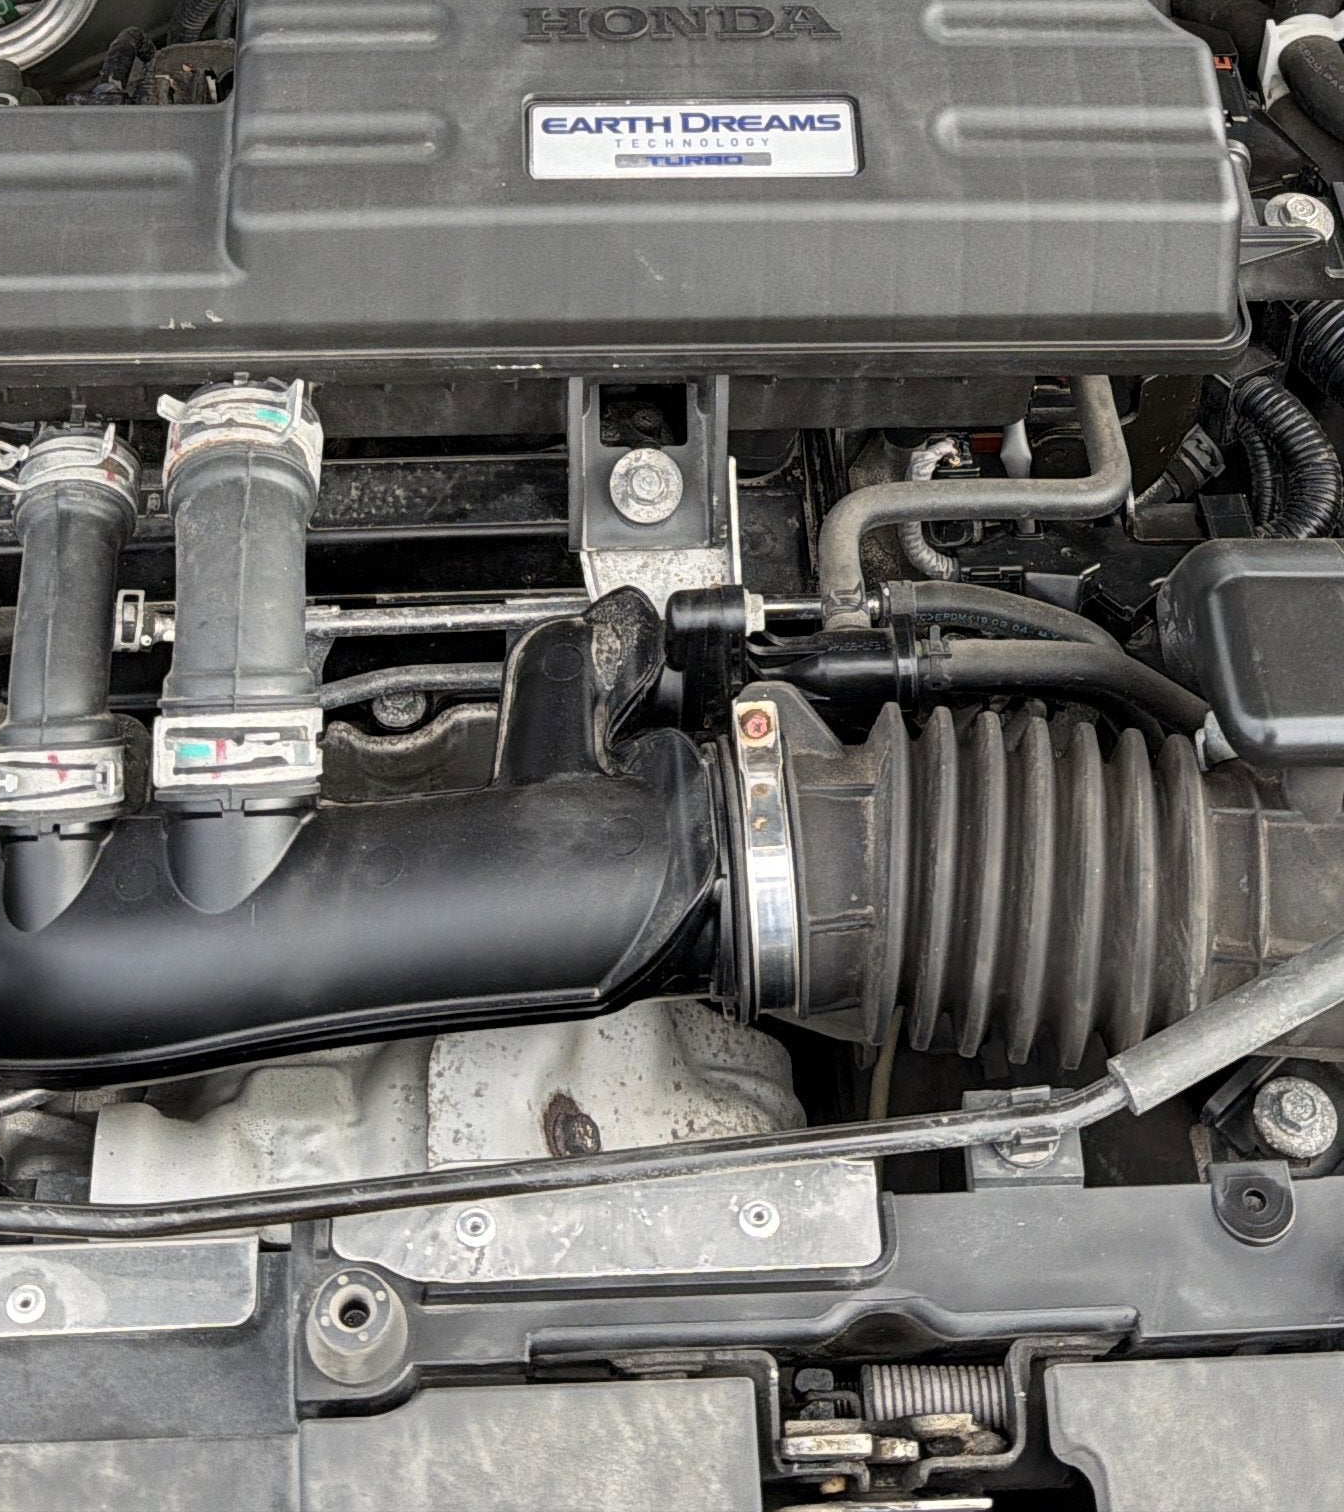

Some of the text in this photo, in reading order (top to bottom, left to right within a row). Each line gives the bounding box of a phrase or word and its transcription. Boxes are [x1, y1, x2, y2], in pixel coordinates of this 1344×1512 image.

[521, 4, 843, 43] HONDA
[540, 112, 843, 135] EARTH DREAMS
[613, 137, 772, 149] TECHNOLOGY
[644, 155, 744, 167] TURBO
